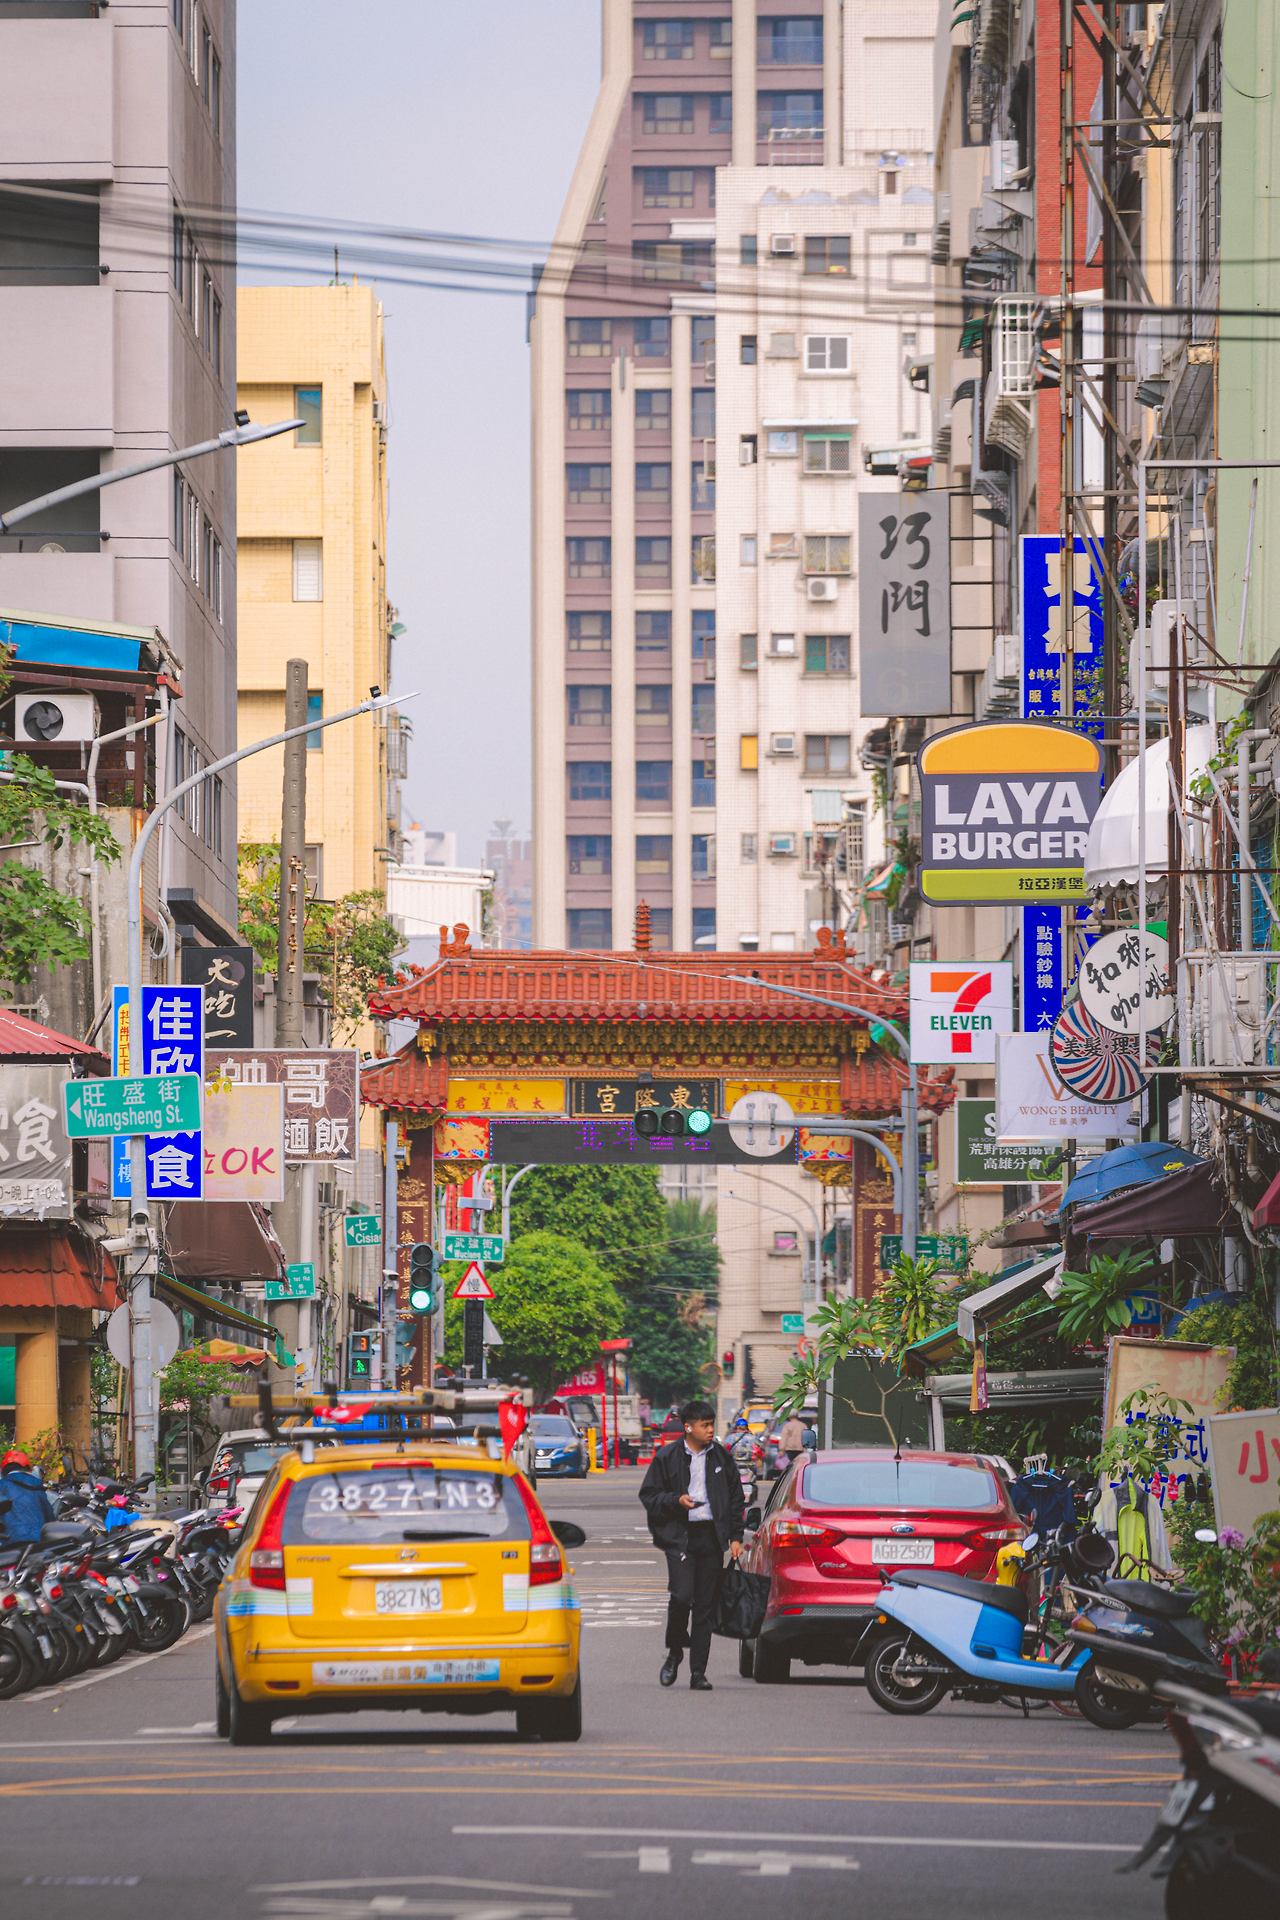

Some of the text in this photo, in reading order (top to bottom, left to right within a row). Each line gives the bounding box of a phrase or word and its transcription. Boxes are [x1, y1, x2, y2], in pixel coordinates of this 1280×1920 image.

[934, 782, 1089, 825] LAYA
[932, 831, 1088, 860] BURGER
[1018, 877, 1084, 891] 拉亞漢堡
[82, 1079, 182, 1108] 旺盛街
[147, 996, 195, 1189] 佳欣食
[84, 1104, 184, 1130] Wangsheng St.
[1019, 1105, 1118, 1116] WONG'S BEAUTY
[983, 1158, 1042, 1170] 高雄分會
[320, 1481, 497, 1512] 3827-N3
